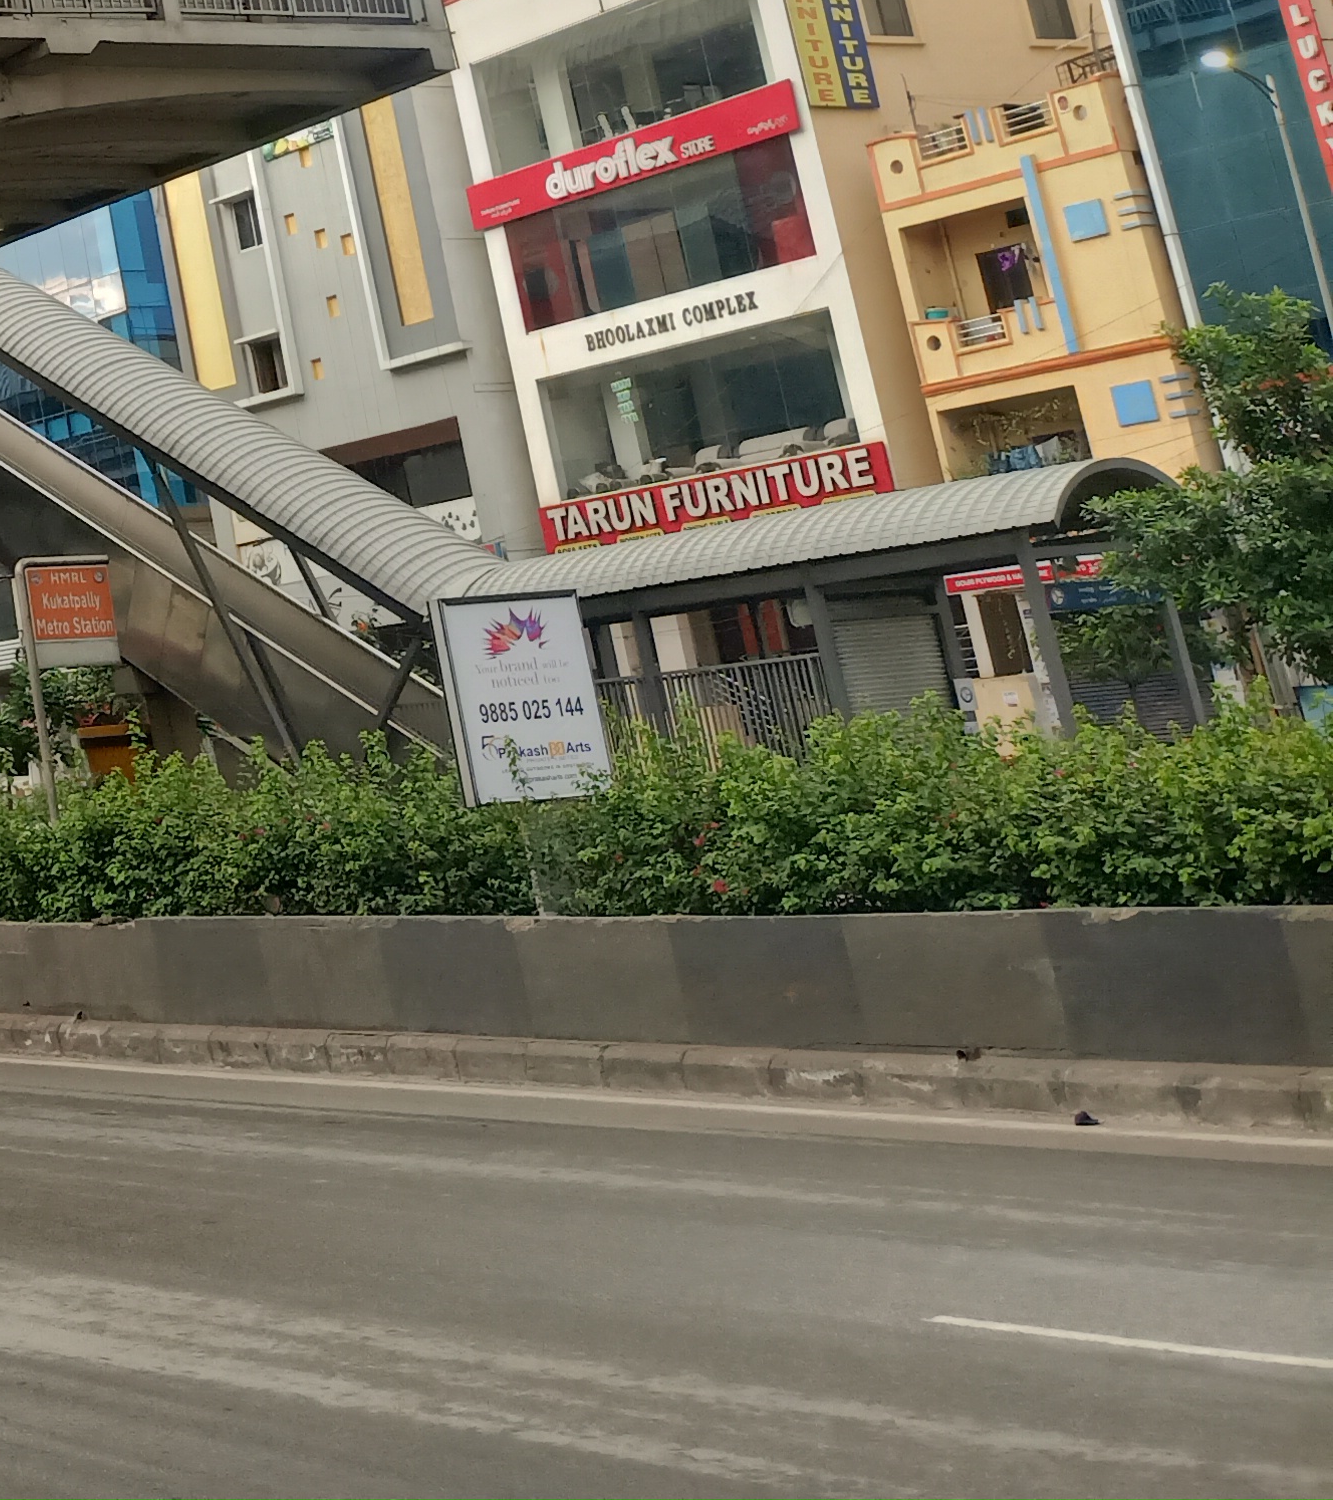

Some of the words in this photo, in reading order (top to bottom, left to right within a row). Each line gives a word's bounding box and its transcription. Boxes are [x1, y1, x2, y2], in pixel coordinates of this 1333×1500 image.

[545, 136, 679, 200] duroflex
[680, 135, 716, 159] STORE
[585, 312, 677, 352] BHOOLAXMI
[682, 291, 759, 327] COMPLEX
[546, 491, 658, 542] TARUN
[660, 448, 876, 523] FURNITURE
[50, 571, 87, 585] HMRL
[41, 591, 101, 611] Kukatpally
[36, 618, 70, 636] Metro
[72, 616, 113, 634] Station
[475, 663, 498, 674] Your
[499, 657, 538, 673] brand
[491, 672, 539, 689] noticed
[479, 701, 519, 724] 9885
[522, 699, 552, 720] 025
[555, 696, 584, 718] 144
[498, 744, 549, 759] Pkash
[566, 742, 592, 754] Arts
